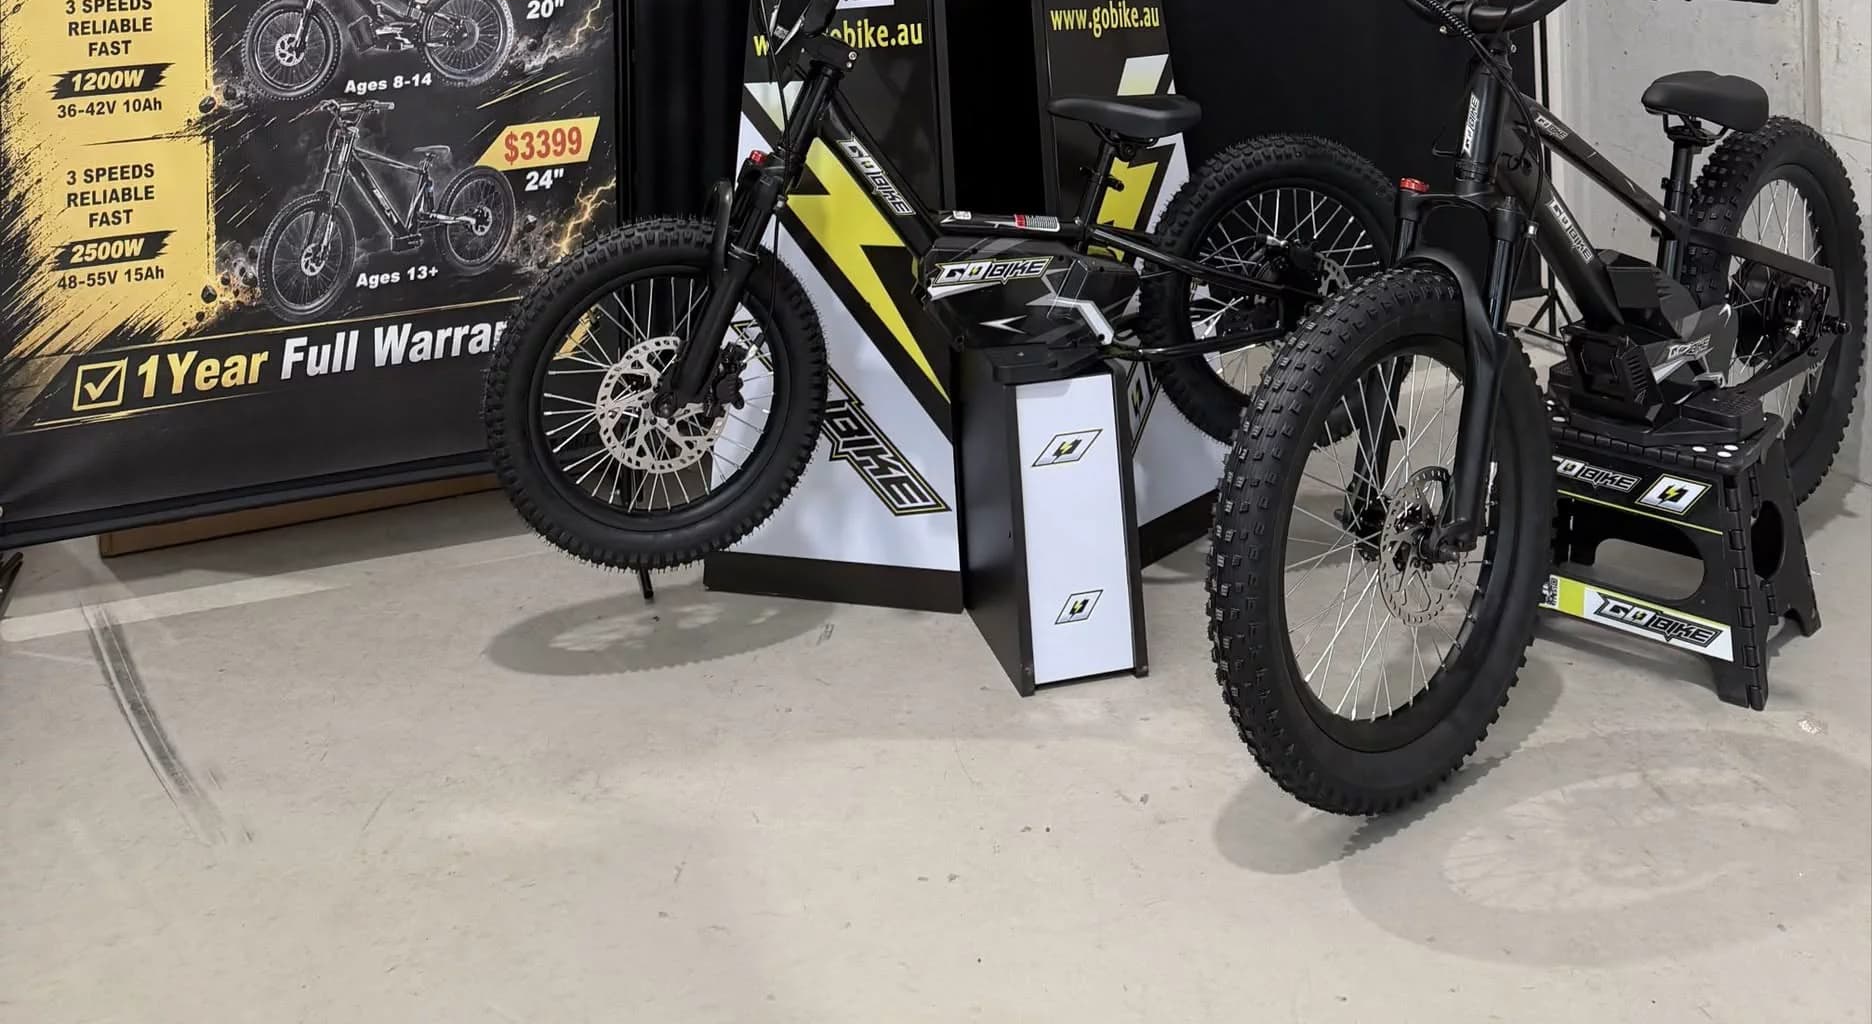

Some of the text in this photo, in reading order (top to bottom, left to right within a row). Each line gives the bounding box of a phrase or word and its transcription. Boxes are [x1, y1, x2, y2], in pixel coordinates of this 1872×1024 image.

[65, 0, 76, 15] 3
[1050, 0, 1160, 38] www.gobike.au
[68, 17, 152, 36] RELIABLE
[88, 40, 131, 57] FAST
[71, 69, 144, 92] 1200W
[344, 73, 432, 96] Ages 8-14
[57, 98, 162, 118] 36-42V 10Ah
[504, 126, 582, 166] $3399
[66, 163, 154, 185] 3 SPEEDS
[525, 169, 564, 191] 24"
[67, 185, 155, 208] RELIABLE
[89, 209, 133, 228] FAST
[70, 238, 144, 264] 2500W
[57, 266, 164, 290] 48-55V 15Ah
[356, 265, 439, 288] Ages 13+
[281, 329, 360, 380] Full
